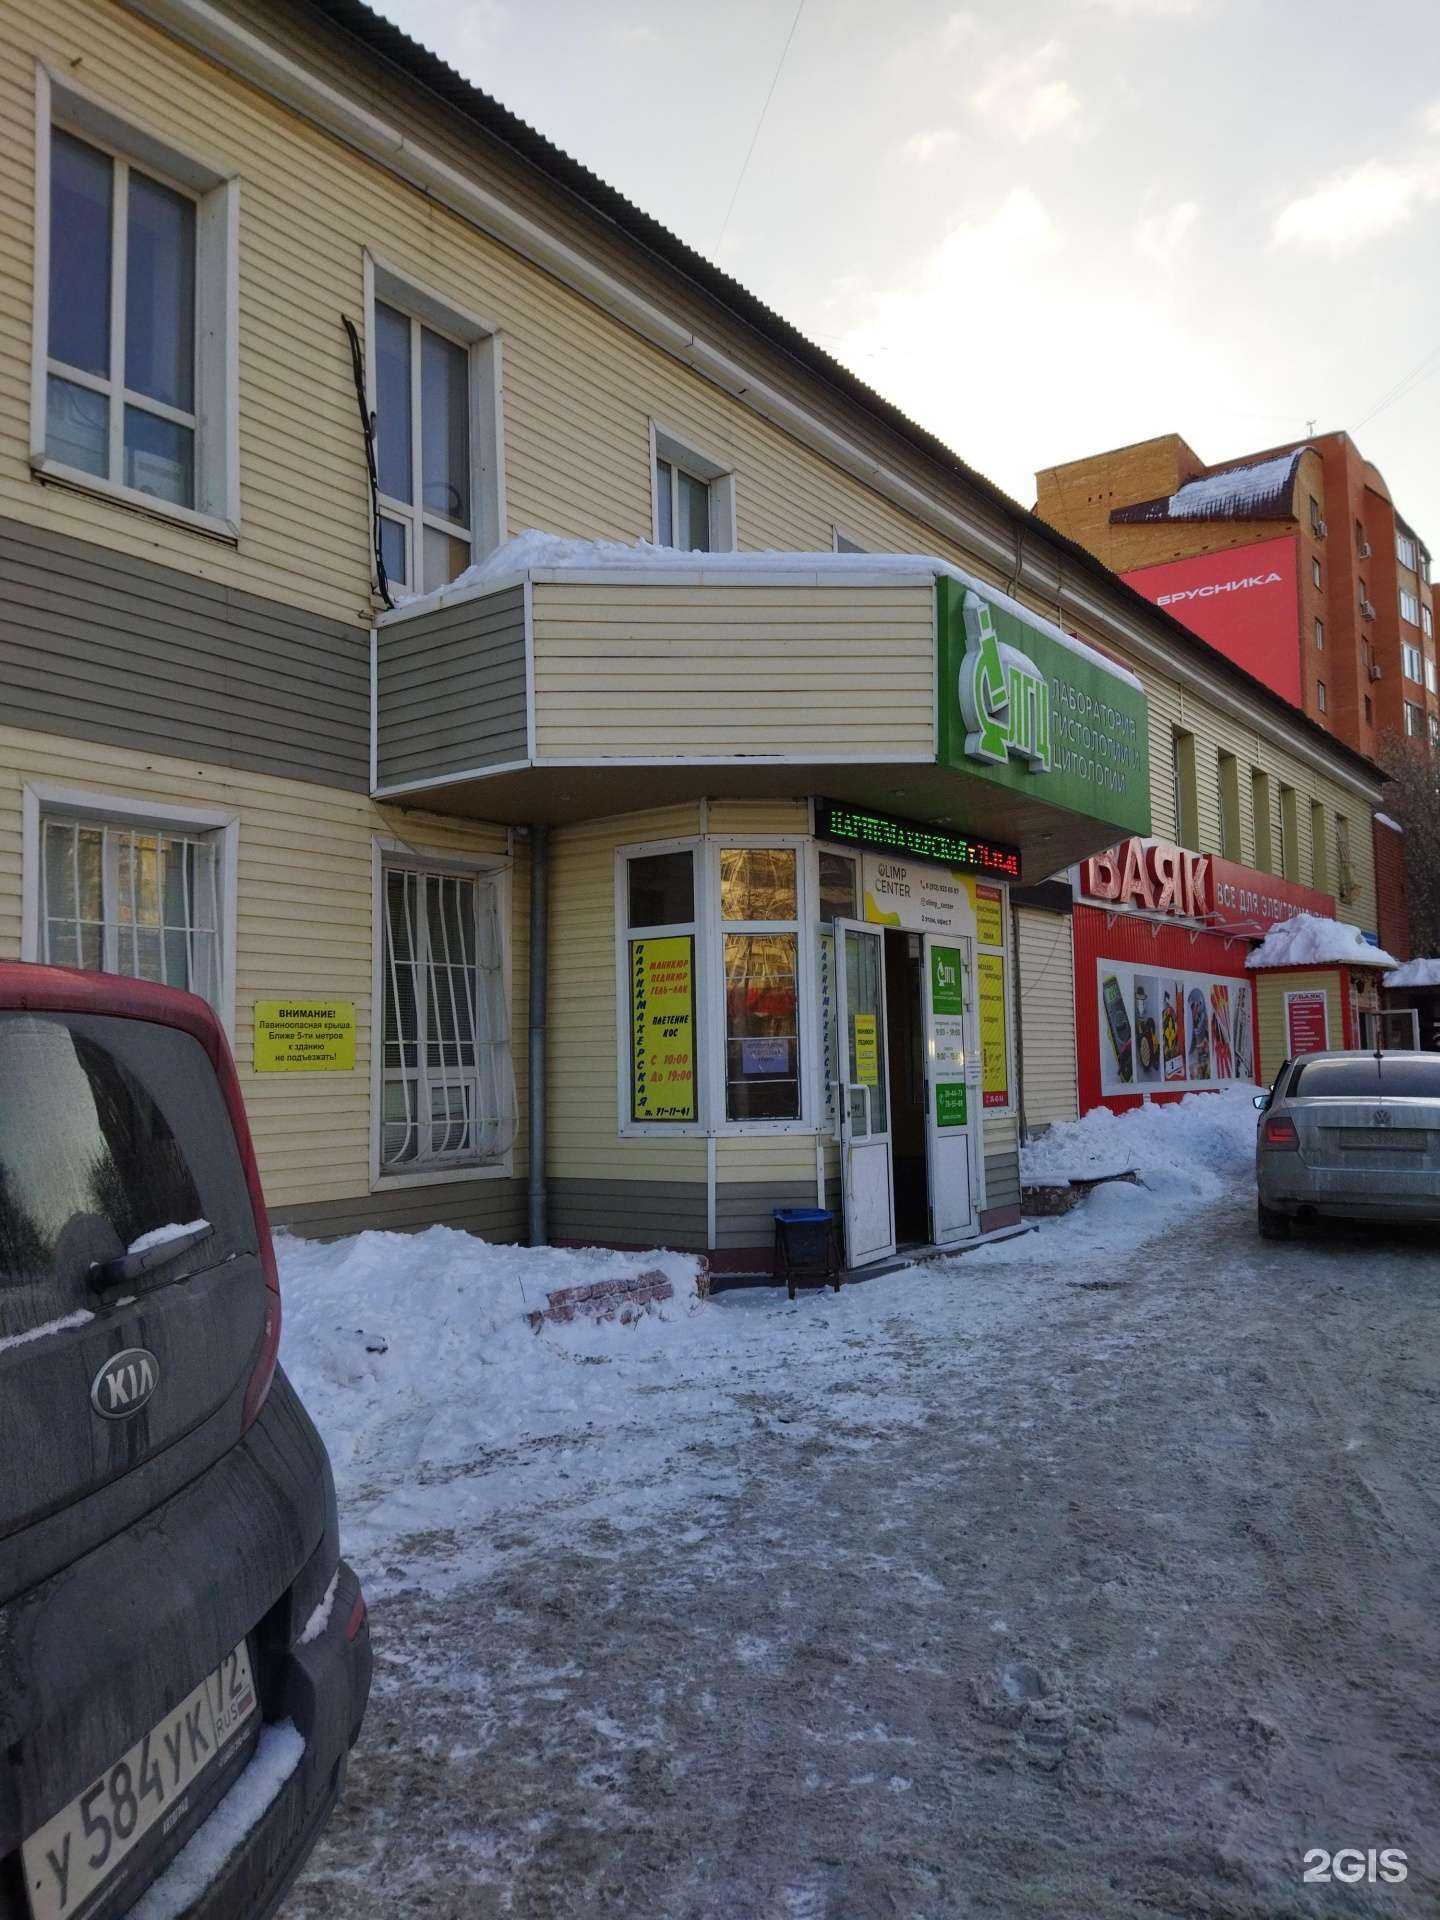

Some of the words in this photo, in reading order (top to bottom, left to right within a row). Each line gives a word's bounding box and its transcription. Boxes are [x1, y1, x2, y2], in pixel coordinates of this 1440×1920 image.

[1157, 572, 1282, 606] БРУСНИКА
[1053, 677, 1137, 741] ЛАБОРАТОРИЯ
[1053, 710, 1128, 765] ГИСТОЛОГИИ
[1053, 744, 1127, 795] ЦИТОЛОГИИ
[878, 863, 907, 880] OLIMP
[875, 879, 911, 898] CENTER
[1216, 882, 1236, 908] ВСЕ
[1240, 888, 1259, 914] ДЛЯ
[279, 1009, 336, 1018] ВНИМАНИЕ!
[652, 1014, 689, 1025] ПЛЕТЕНИЕ
[259, 1021, 322, 1029] Лавиноопасная
[324, 1022, 352, 1031] крыша.
[269, 1031, 295, 1039] Ближе
[297, 1031, 313, 1039] 5-ти
[316, 1032, 343, 1040] метров
[663, 1028, 678, 1037] КОС
[294, 1043, 325, 1051] зданию
[287, 1053, 337, 1062] подъезжать!
[664, 1054, 688, 1065] 10:00
[668, 1070, 692, 1081] 19:00
[656, 1107, 690, 1116] 71-11-41
[106, 1359, 154, 1409] KIA
[215, 1703, 239, 1742] RUS
